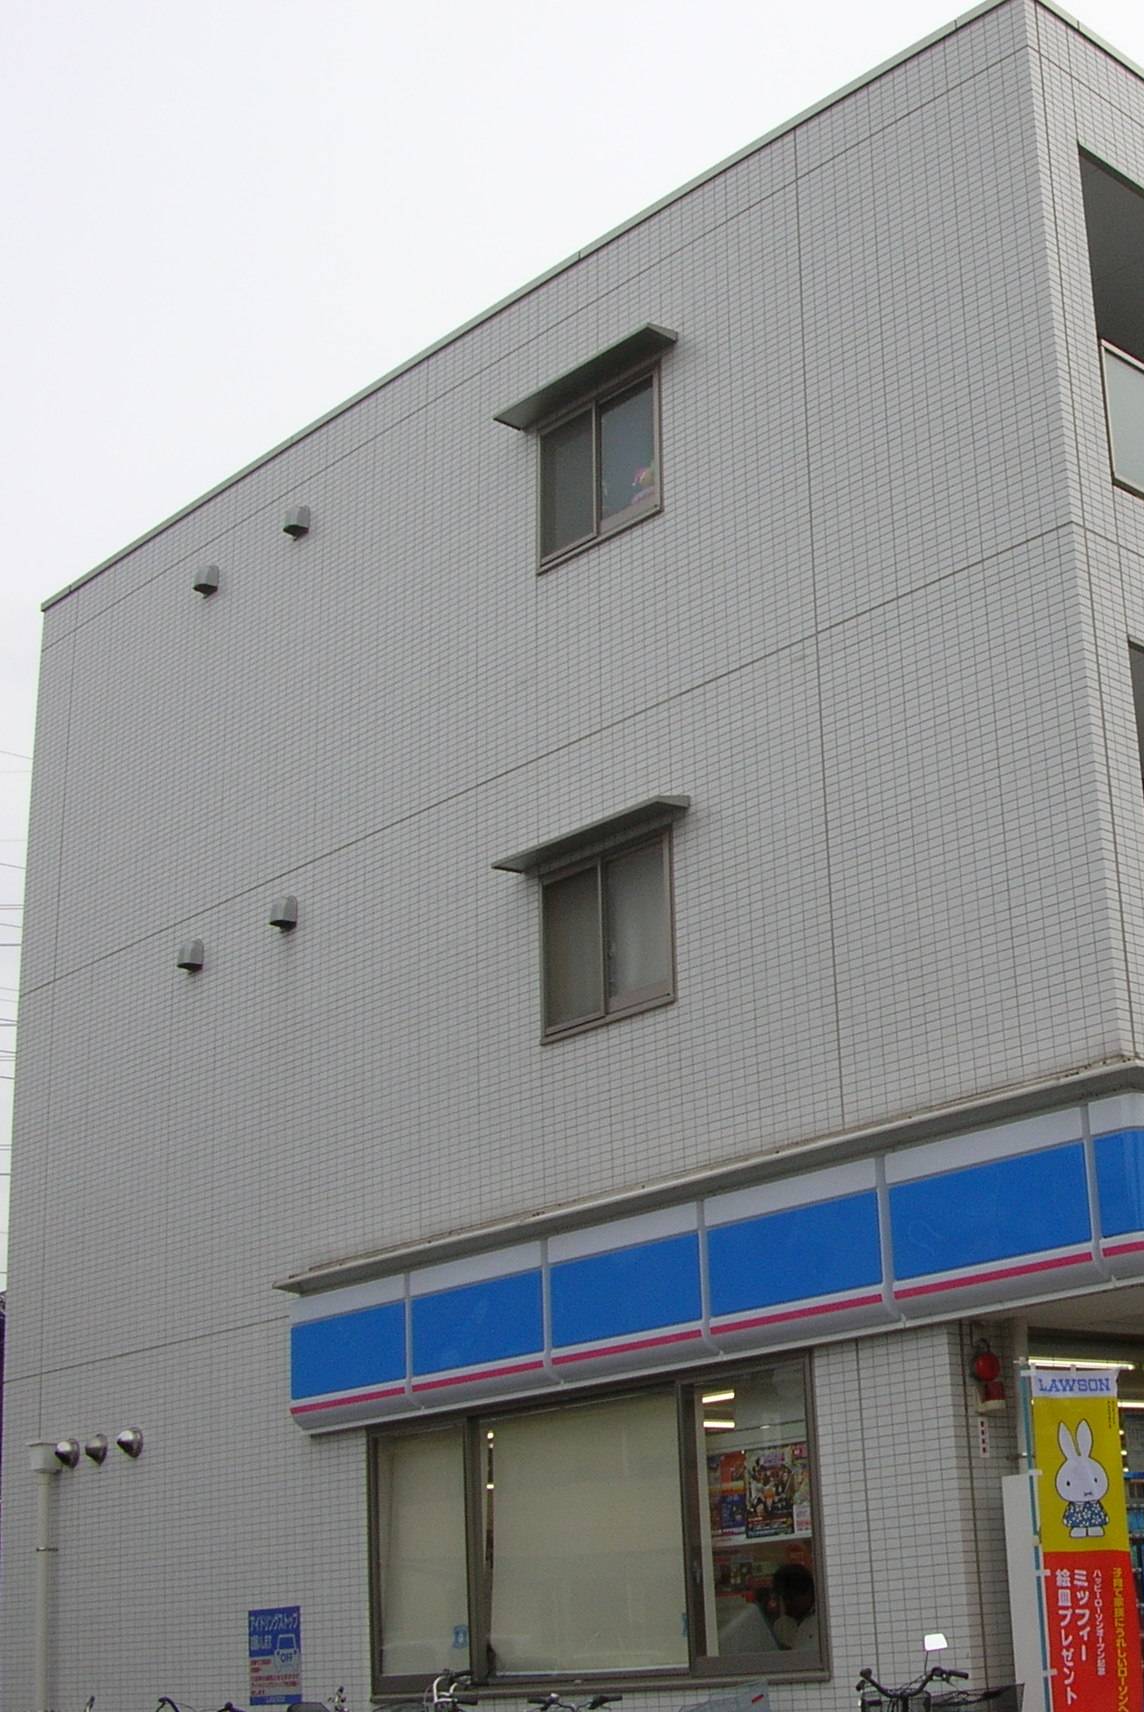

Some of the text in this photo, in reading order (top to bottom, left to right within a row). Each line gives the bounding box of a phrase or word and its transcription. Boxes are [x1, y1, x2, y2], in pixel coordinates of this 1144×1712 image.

[1038, 1378, 1111, 1393] LAWSON
[1056, 1569, 1077, 1705] 絵皿プレゼント
[1073, 1569, 1091, 1661] ミッフィー
